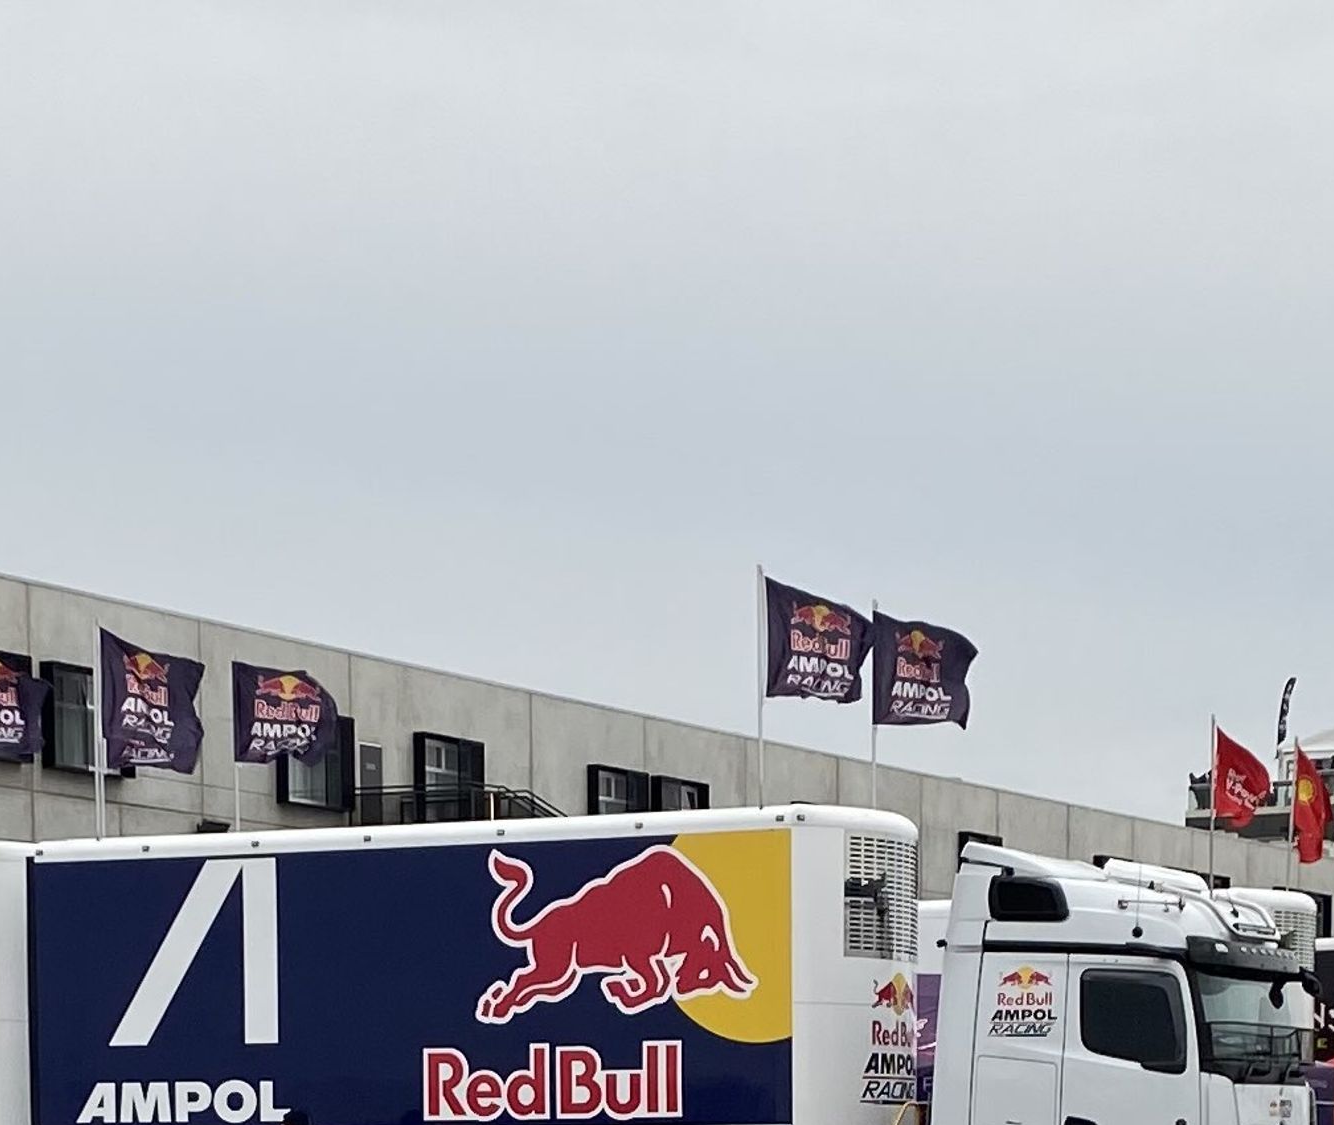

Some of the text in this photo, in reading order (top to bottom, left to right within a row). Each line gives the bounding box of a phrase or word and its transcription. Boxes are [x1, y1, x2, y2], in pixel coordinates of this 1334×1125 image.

[891, 681, 952, 701] AMPOL
[997, 991, 1053, 1006] Red Bull
[991, 1008, 1058, 1021] AMPOL
[872, 1020, 899, 1046] Red
[988, 1023, 1053, 1036] RACING
[864, 1052, 916, 1076] AMPO
[423, 1039, 684, 1122] Red Bull
[75, 1079, 292, 1124] AMPOL
